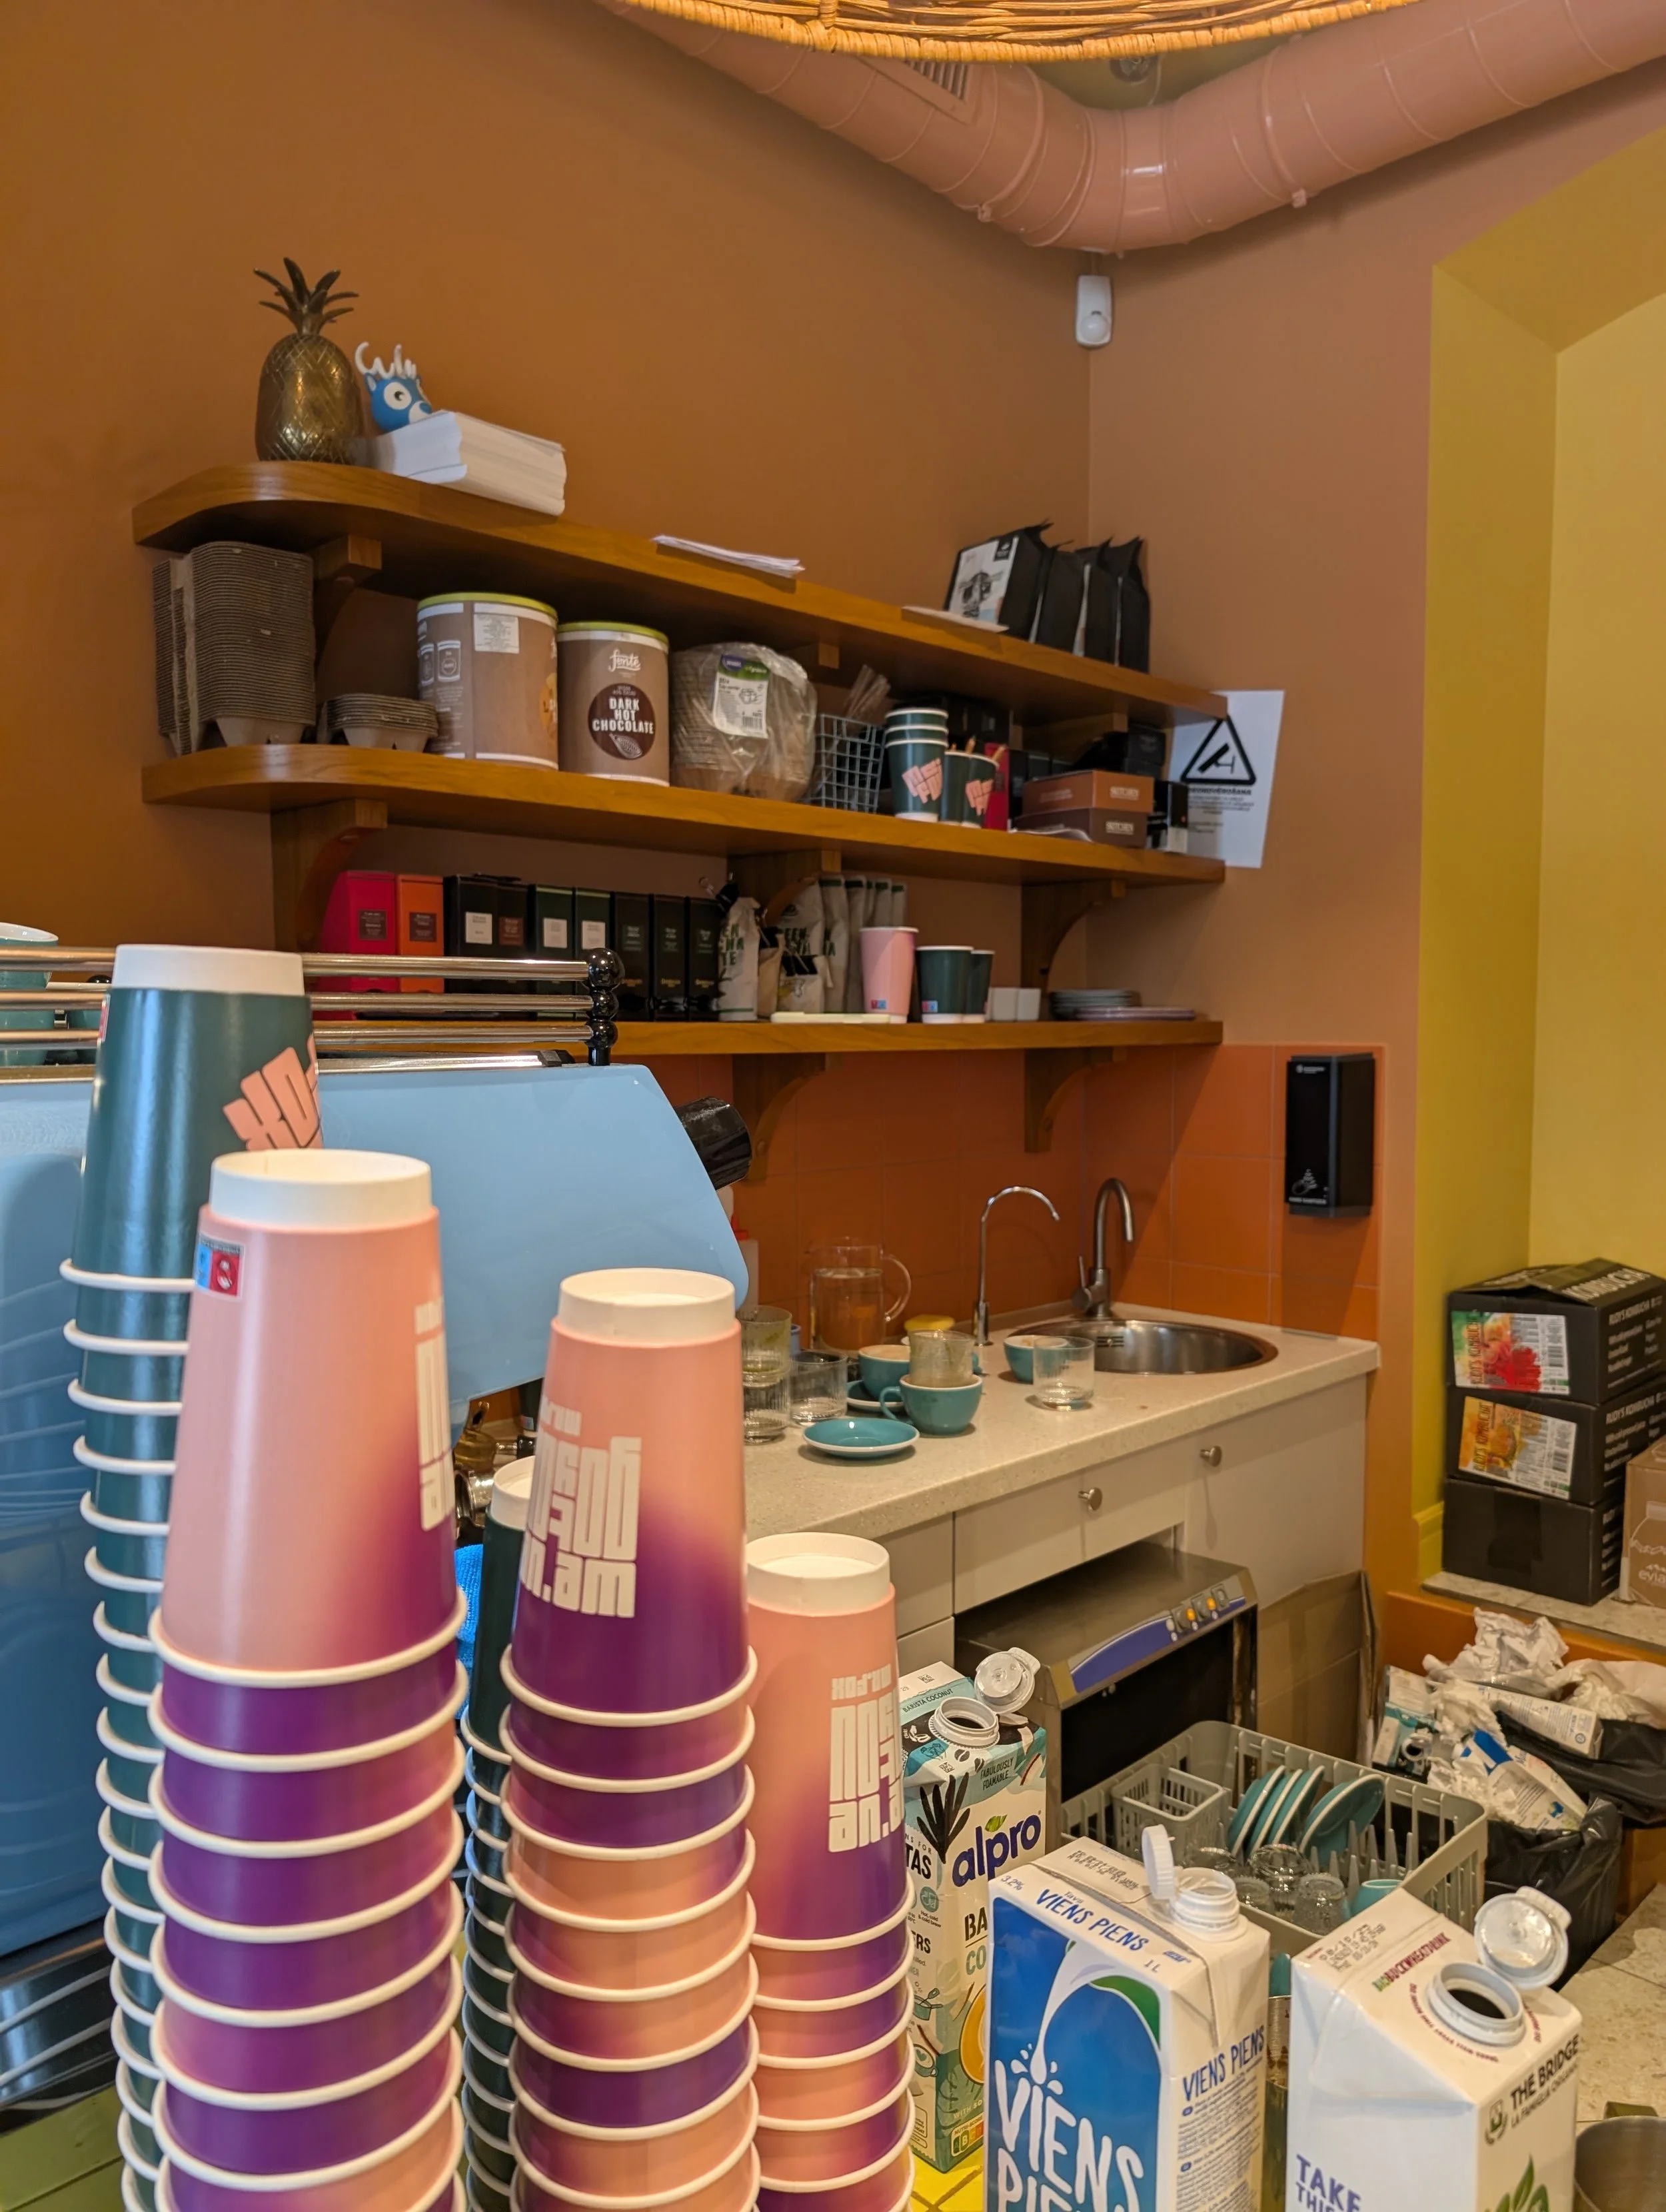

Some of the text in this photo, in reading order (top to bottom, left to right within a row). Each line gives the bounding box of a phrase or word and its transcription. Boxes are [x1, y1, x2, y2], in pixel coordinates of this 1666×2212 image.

[609, 698, 640, 711] DARK
[614, 710, 636, 721] HOT
[592, 718, 654, 734] CHOCOLATE
[1638, 1570, 1666, 1584] evia
[902, 1688, 953, 1713] BARISTA COCONUT
[980, 1757, 1014, 1780] FABULOUSLY
[982, 1770, 1010, 1790] FOAMABLE
[918, 1842, 932, 1856] FOR
[952, 1814, 1041, 1887] alpro
[1000, 1875, 1025, 1892] 3.2%
[1036, 1888, 1150, 1951] VIENS PIENS
[1183, 2024, 1265, 2101] VIENS PIENS
[1510, 2073, 1537, 2110] THE
[1538, 2033, 1579, 2087] BRIDGE
[953, 2105, 972, 2119] WITH
[1511, 2113, 1520, 2129] LA
[962, 2135, 968, 2146] B
[994, 2059, 1145, 2212] VIENS
[1296, 2153, 1362, 2212] TAKE
